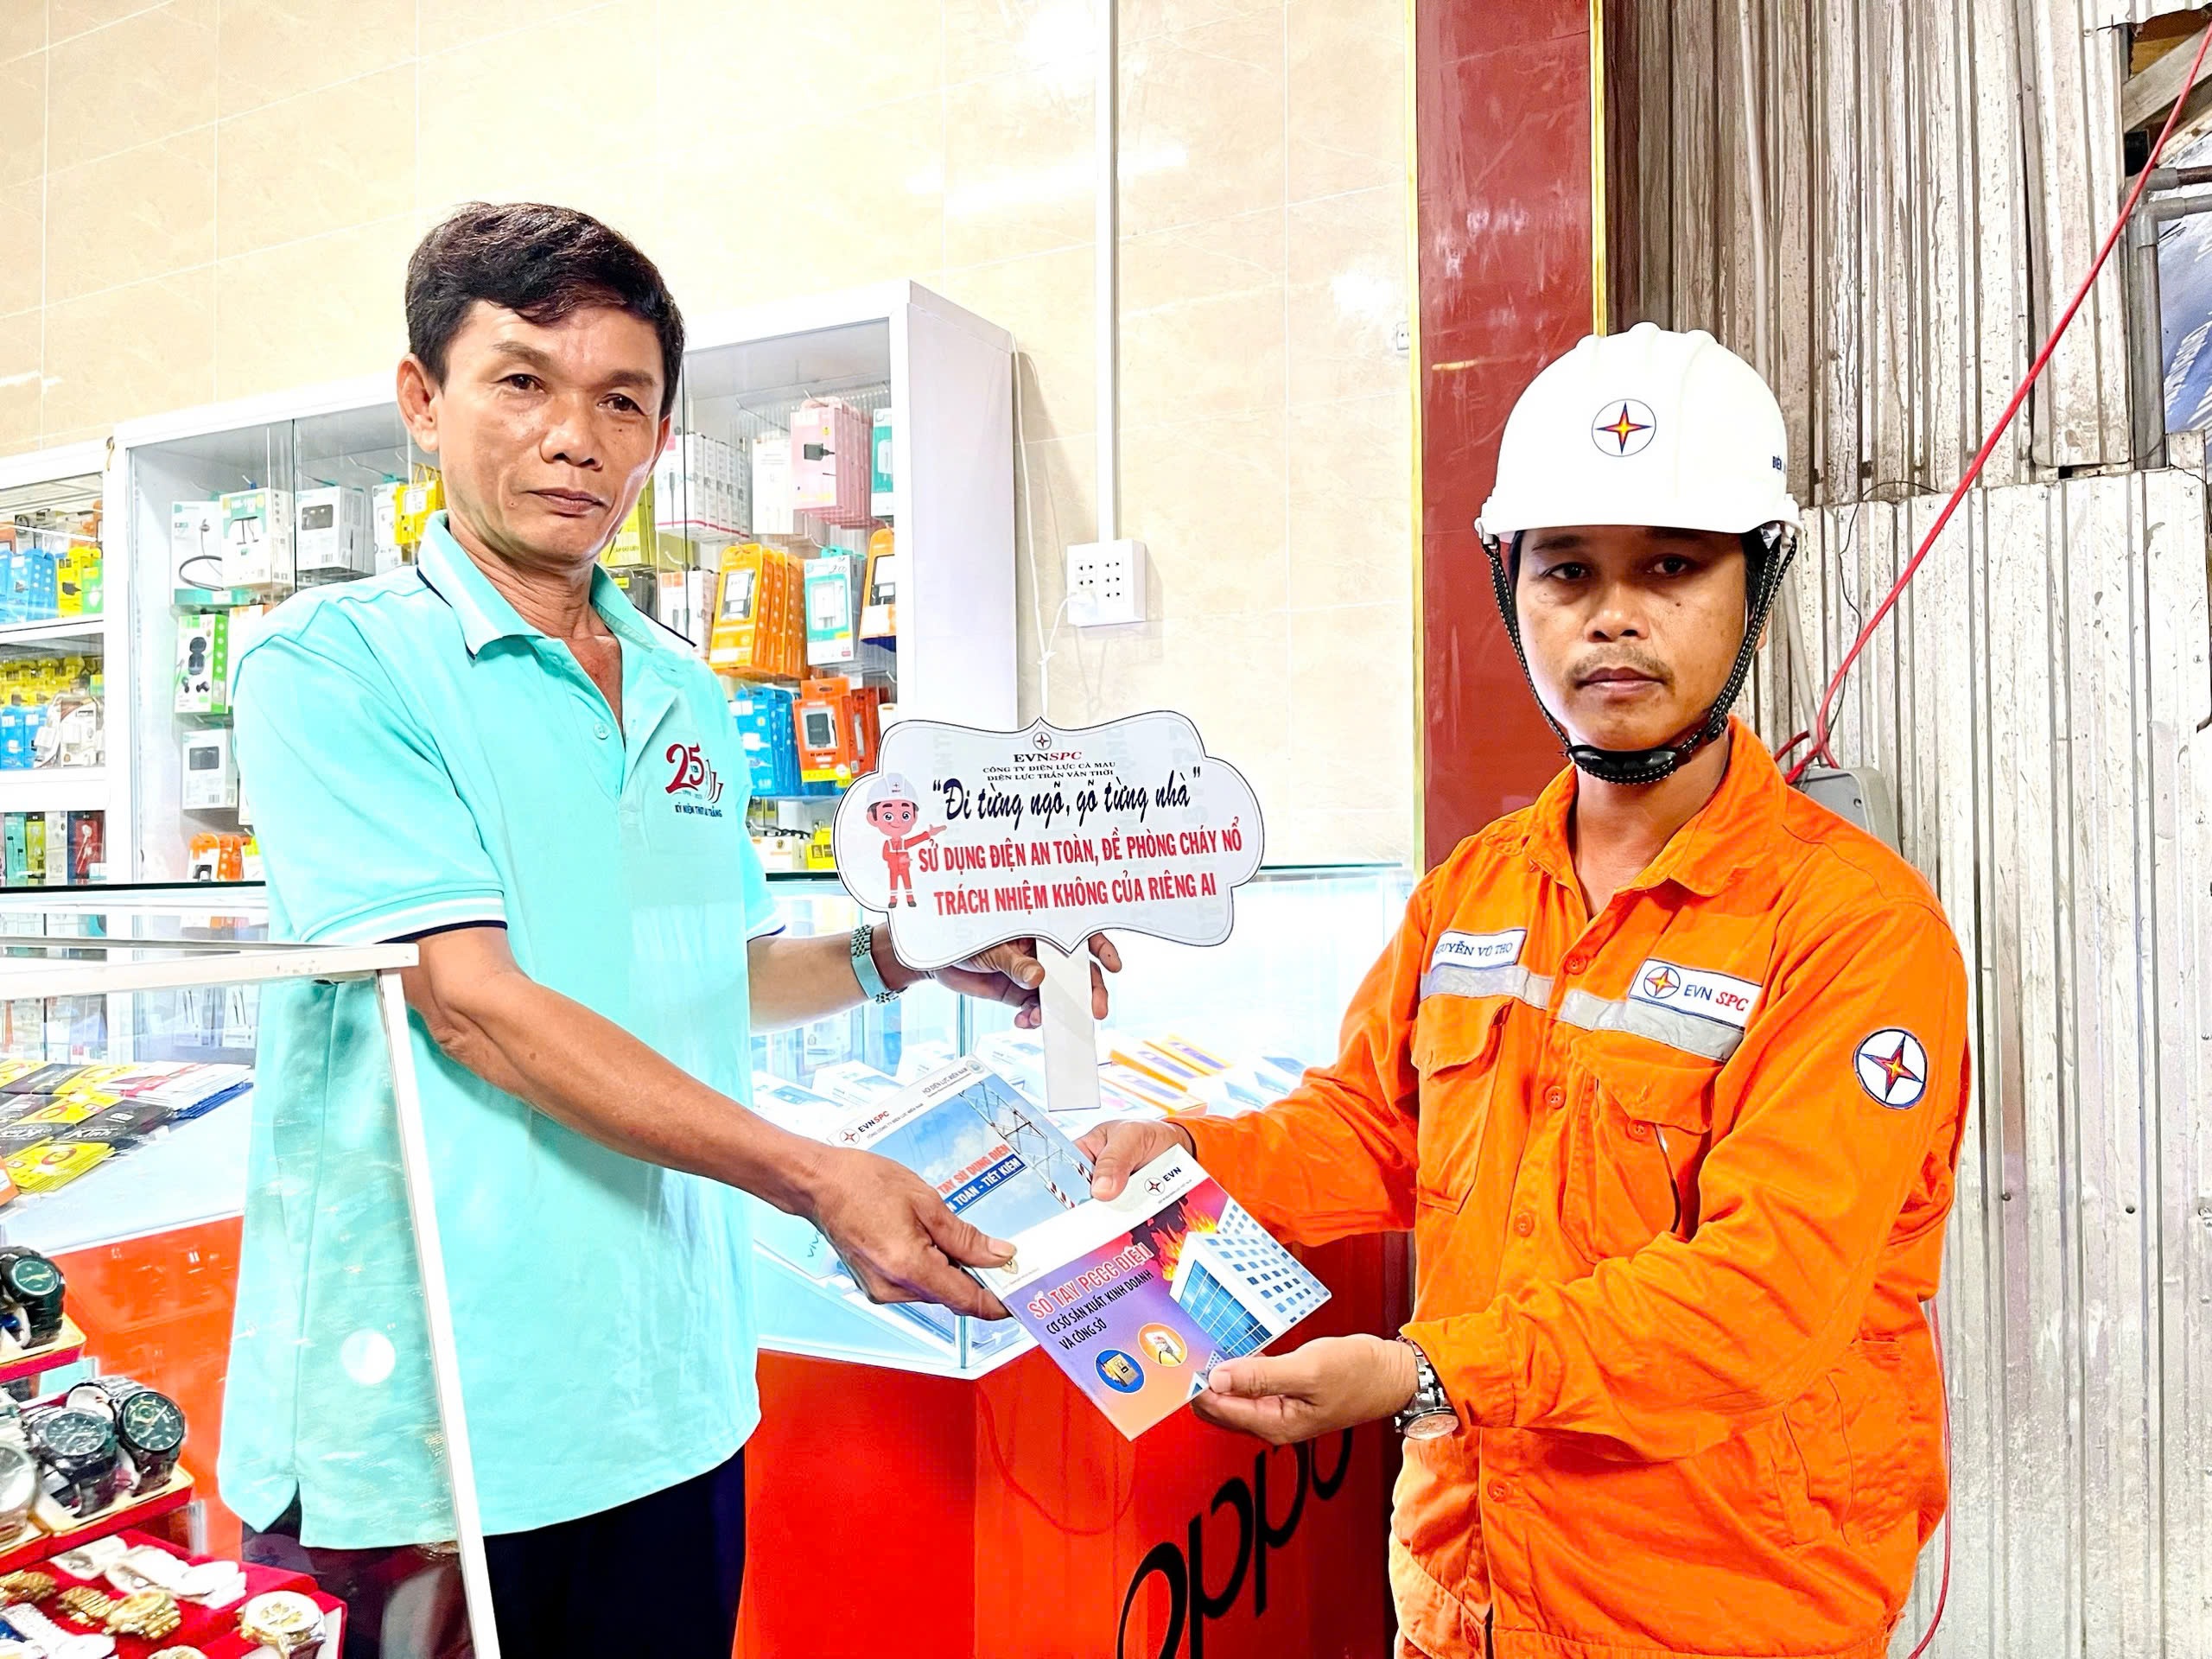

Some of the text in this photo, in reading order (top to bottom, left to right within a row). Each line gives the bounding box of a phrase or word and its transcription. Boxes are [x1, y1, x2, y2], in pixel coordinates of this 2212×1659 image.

[664, 741, 705, 794] 25
[1013, 751, 1083, 763] EVNSPC
[1014, 772, 1035, 781] LỰC
[977, 783, 1024, 830] từng
[1104, 776, 1149, 823] từng
[918, 816, 1243, 875] SỬ DỤNG ĐIỆN AN TOÀN, ĐỀ PHÒNG CHÁY NỔ
[933, 869, 1217, 916] TRÁCH NHIỆM KHÔNG CỦA RIÊNG AI
[1684, 983, 1750, 1012] EVN SPC
[858, 1110, 890, 1134] EVNSPC
[937, 1143, 1012, 1195] TAY SỬ DỤNG ĐIỆN
[945, 1201, 957, 1213] N
[952, 1185, 981, 1206] TOÀN
[980, 1169, 1002, 1187] TIẾT
[997, 1157, 1022, 1177] KIỆM
[1162, 1166, 1182, 1182] EVN
[1027, 1290, 1055, 1320] SỔ
[1049, 1280, 1083, 1308] TAY
[1075, 1261, 1121, 1294] PCCC
[1114, 1242, 1155, 1274] ĐIỆN
[1046, 1321, 1060, 1335] CƠ
[1057, 1313, 1071, 1330] SỞ
[1069, 1304, 1089, 1324] SẢN
[1103, 1284, 1128, 1304] KINH
[1123, 1268, 1155, 1292] DOANH
[1058, 1317, 1108, 1351] VÀ CÔNG SỞ
